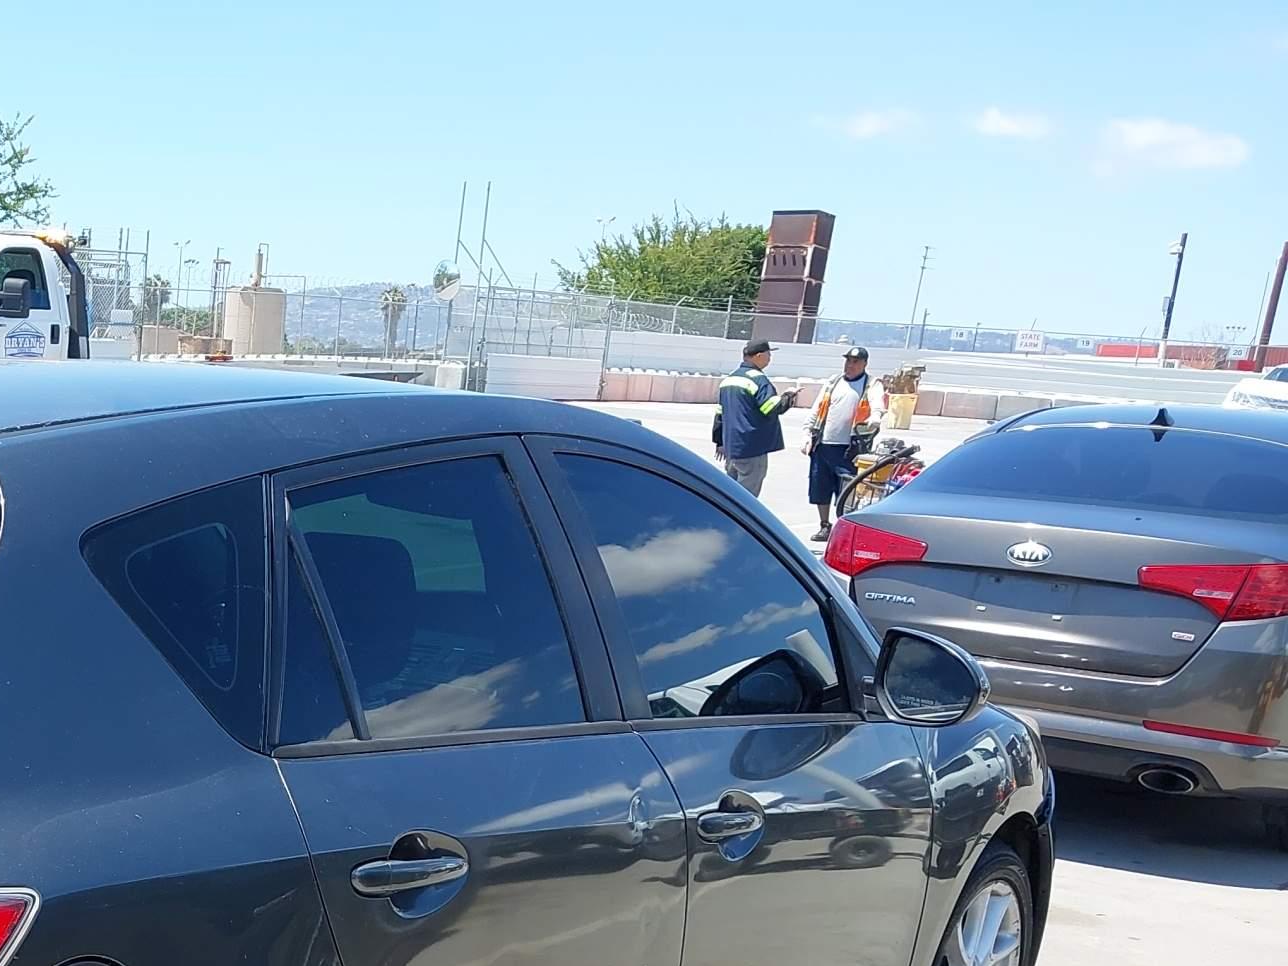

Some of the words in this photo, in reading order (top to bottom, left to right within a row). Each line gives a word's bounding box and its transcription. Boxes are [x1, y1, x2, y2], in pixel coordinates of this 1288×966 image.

[1020, 333, 1041, 341] STATE
[1013, 543, 1044, 561] KIA
[865, 592, 916, 606] OPTIMA
